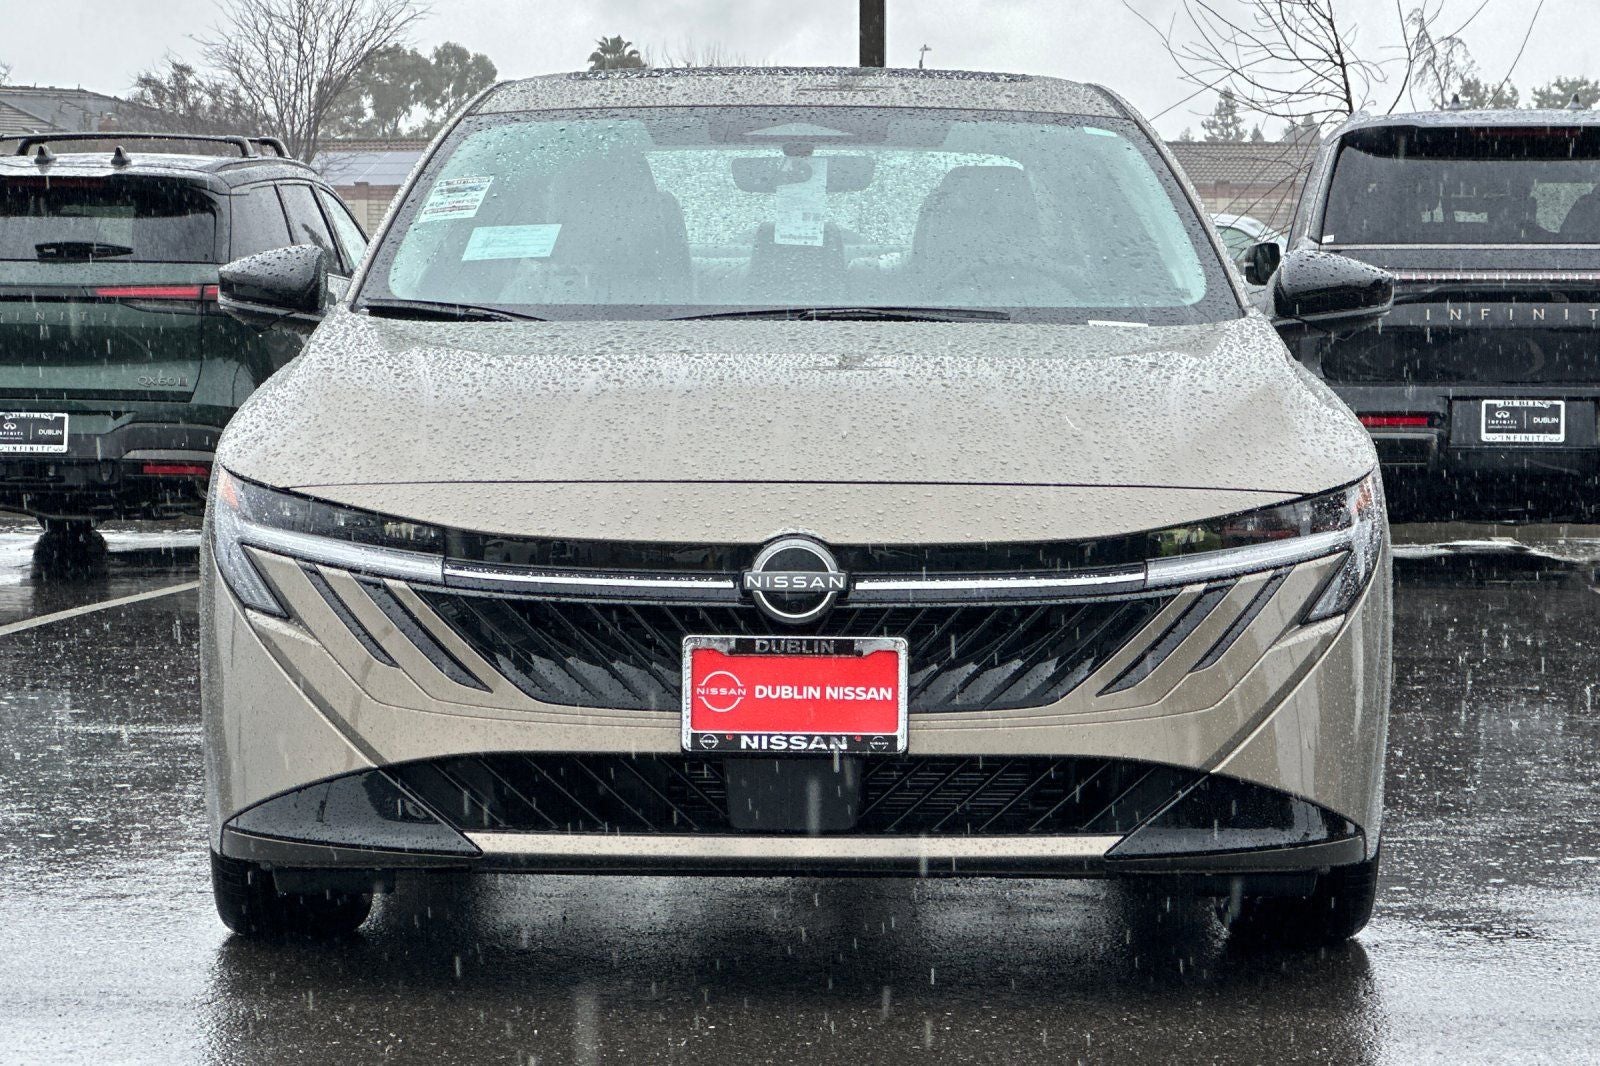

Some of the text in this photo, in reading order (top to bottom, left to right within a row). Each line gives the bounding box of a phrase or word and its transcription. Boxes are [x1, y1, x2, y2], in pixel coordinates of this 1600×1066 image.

[1426, 308, 1599, 321] INFINIT
[138, 376, 176, 388] QX60
[1533, 416, 1559, 424] DUBLIN
[746, 575, 845, 589] NISSAN
[755, 639, 835, 654] DUBLIN
[696, 687, 747, 696] NISSAN
[754, 684, 892, 701] DUBLIN NISSAN
[740, 735, 848, 750] NISSAN
